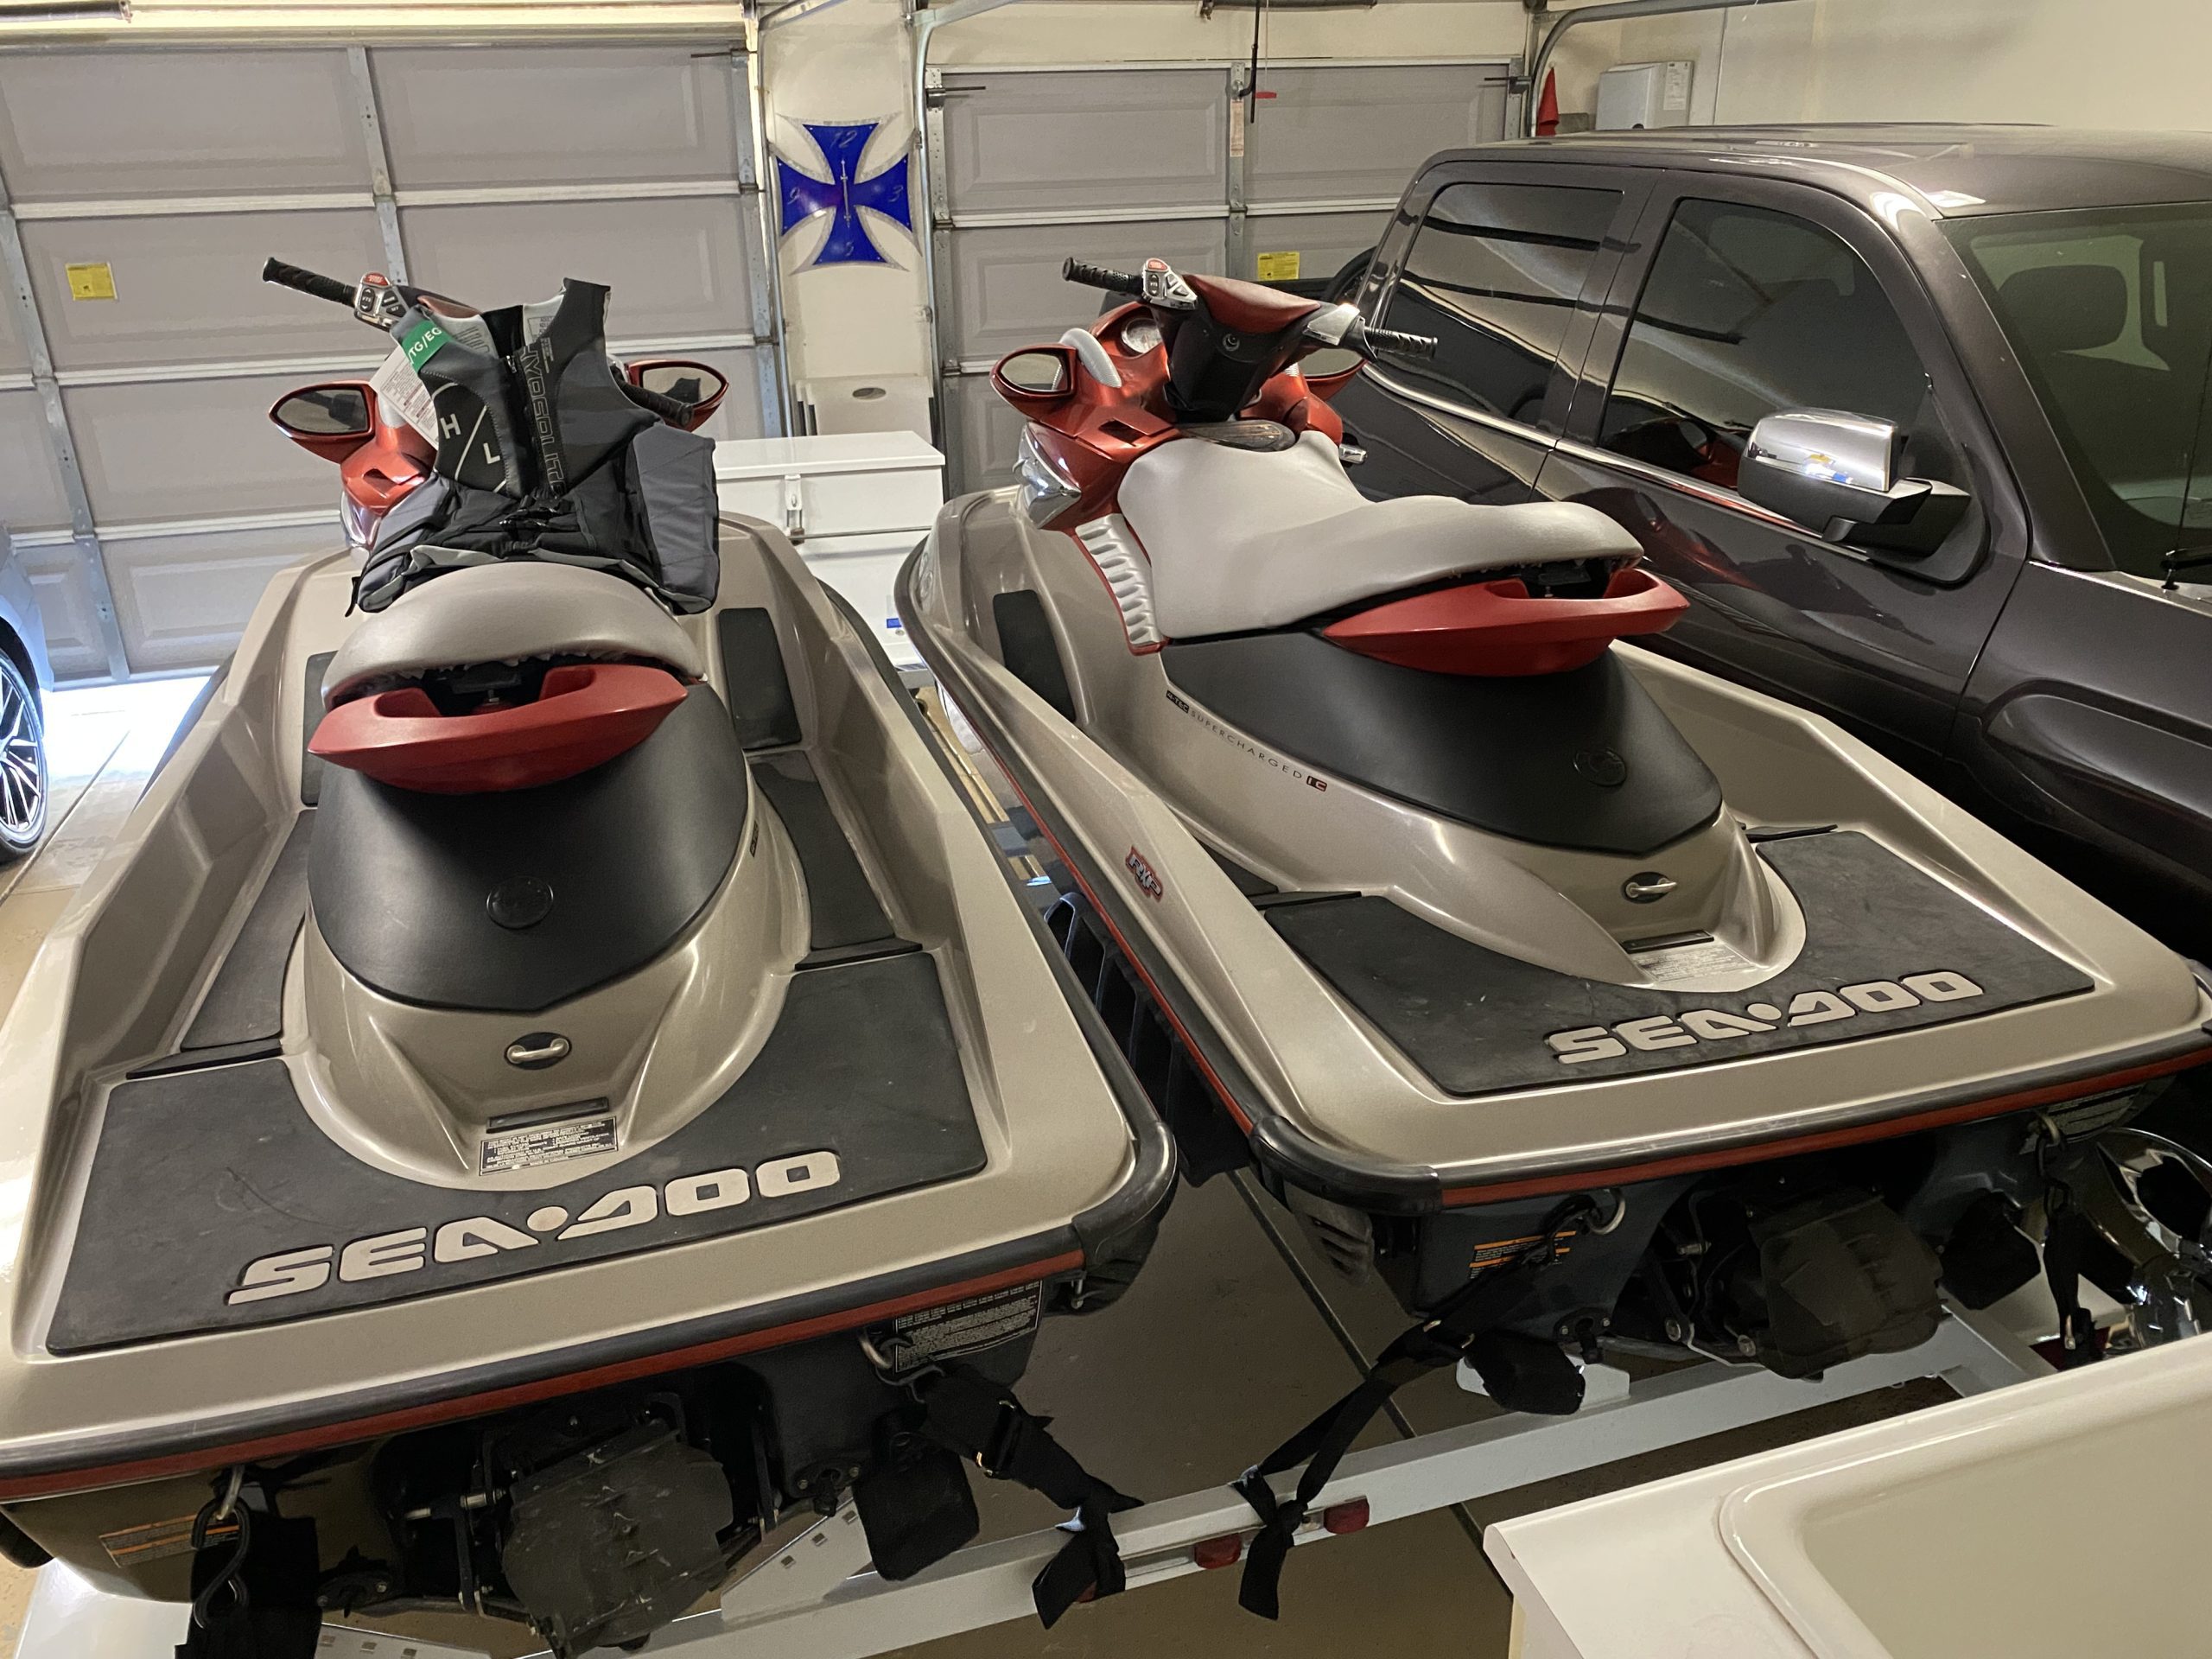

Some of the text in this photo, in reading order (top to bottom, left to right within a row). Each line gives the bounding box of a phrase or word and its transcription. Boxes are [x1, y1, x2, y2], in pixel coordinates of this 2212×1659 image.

[830, 130, 857, 149] 12
[787, 187, 800, 205] 9
[888, 185, 904, 202] 3
[440, 413, 461, 440] H
[484, 442, 501, 465] L
[1190, 710, 1302, 779] SUPERCHARGED
